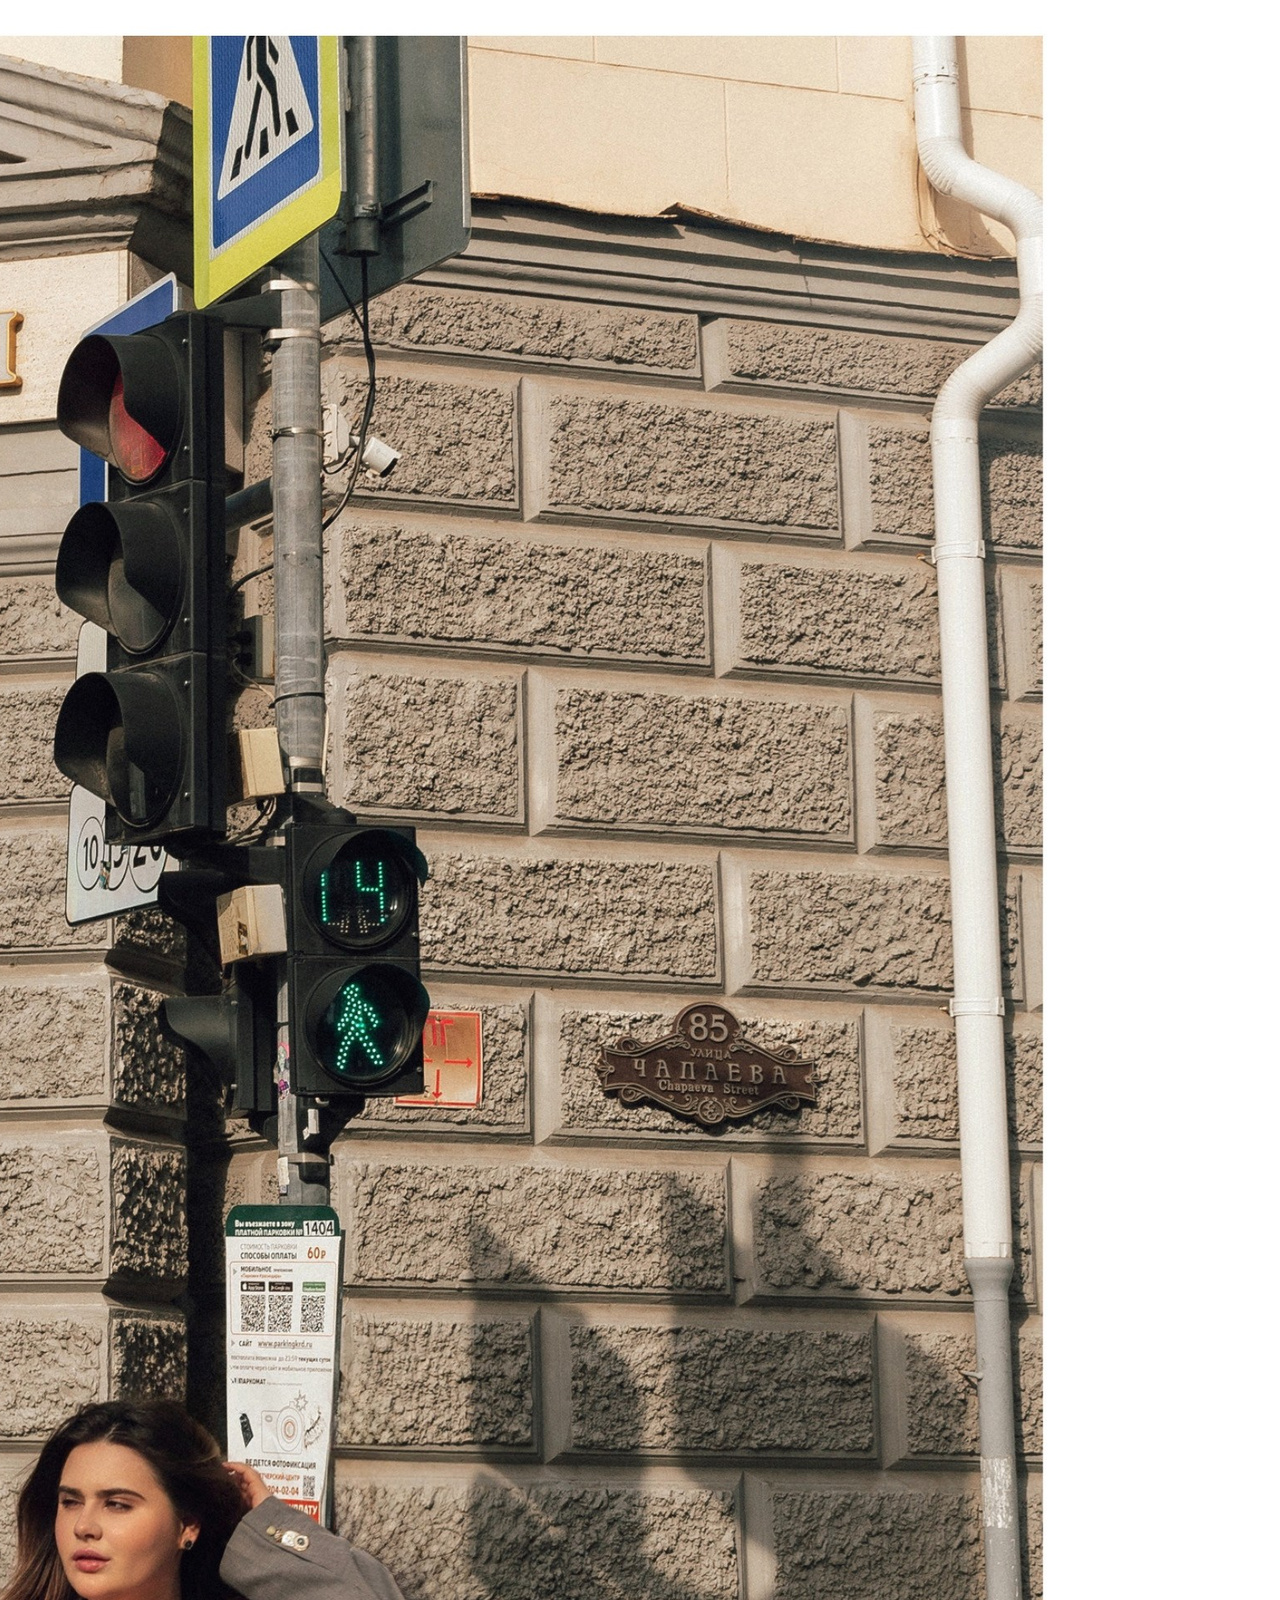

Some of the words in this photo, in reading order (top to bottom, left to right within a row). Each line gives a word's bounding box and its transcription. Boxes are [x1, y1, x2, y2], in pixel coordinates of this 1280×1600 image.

[83, 834, 99, 872] 10
[320, 860, 386, 924] 14
[689, 1012, 729, 1043] 85
[689, 1047, 733, 1061] УЛИЦА
[633, 1058, 788, 1085] ЧАПАЕВА
[658, 1080, 715, 1094] Chapaeva
[723, 1084, 759, 1096] Street
[234, 1219, 244, 1227] Вы
[234, 1228, 262, 1236] ПЛАТНОЙ
[263, 1228, 295, 1236] ПАРКОВКИ
[305, 1221, 334, 1235] 1404
[240, 1252, 270, 1260] СПОСОБЫ
[271, 1252, 297, 1260] ОПЛАТЫ
[238, 1339, 252, 1347] САЙТ
[258, 1340, 313, 1349] www.parkingkrd.ru
[272, 1460, 316, 1470] ФОТОФИКСАЦИЯ
